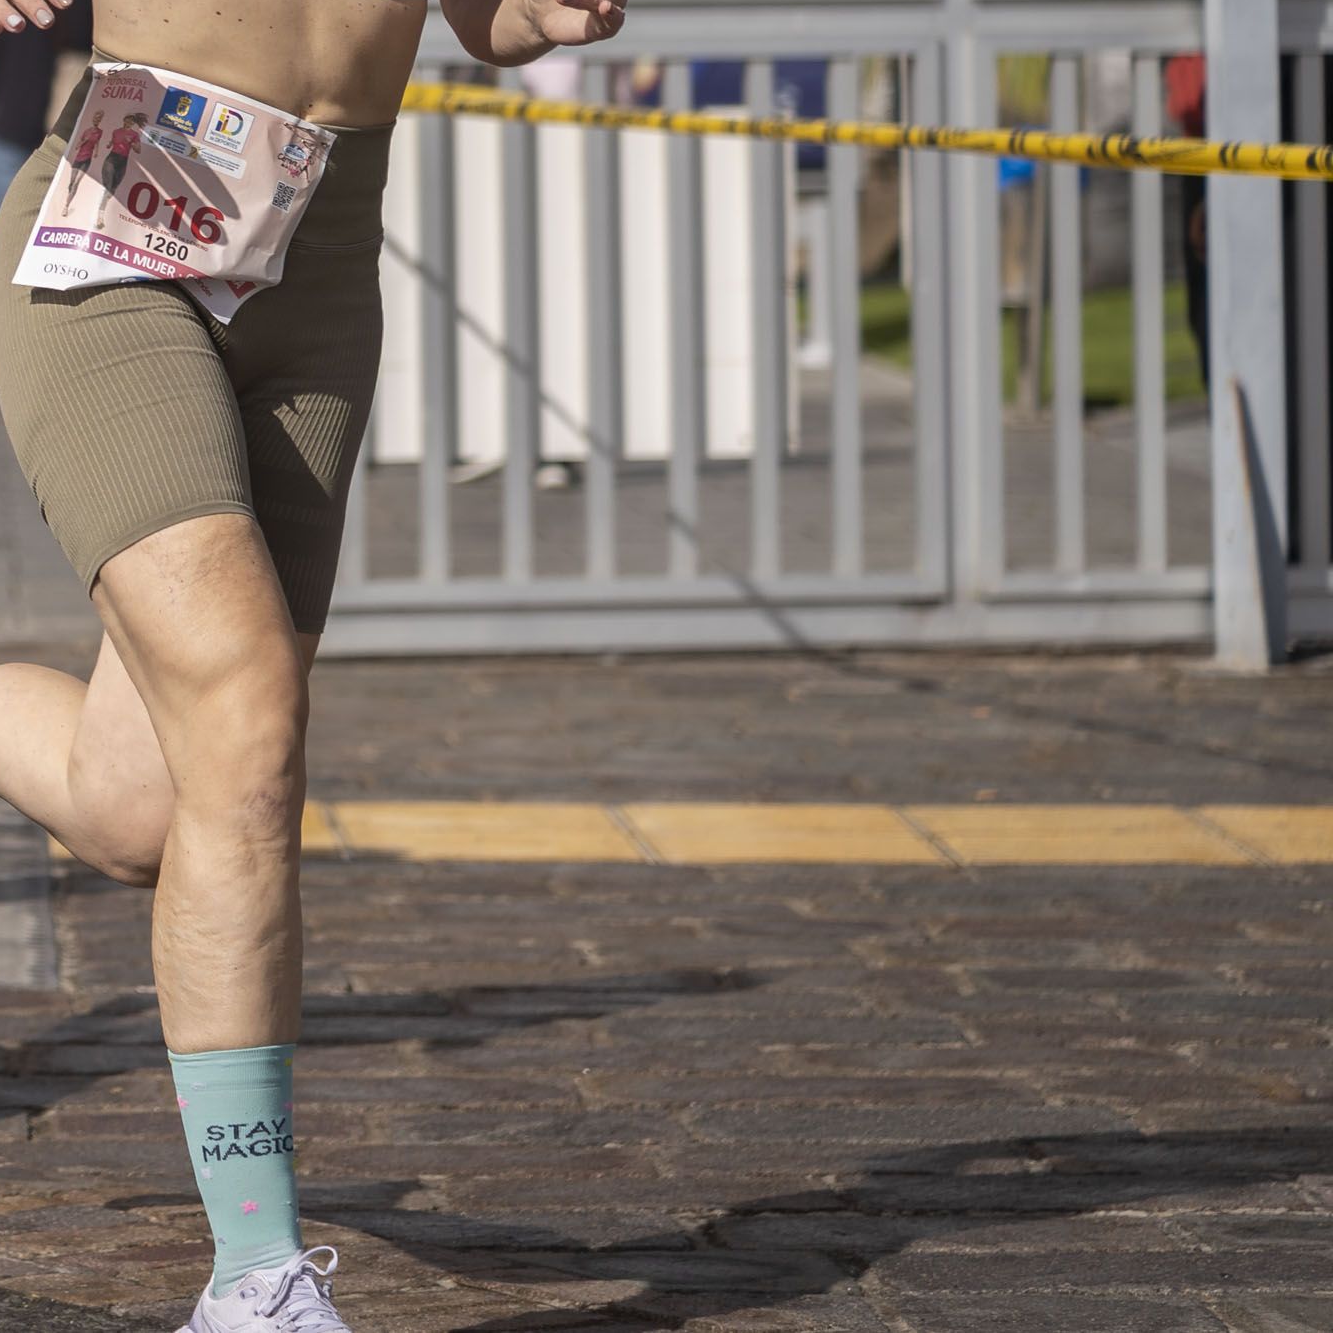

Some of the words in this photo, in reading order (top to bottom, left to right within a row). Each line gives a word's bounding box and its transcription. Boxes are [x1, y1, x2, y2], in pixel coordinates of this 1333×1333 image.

[101, 85, 144, 103] SUMA
[127, 180, 225, 245] 016
[40, 231, 90, 249] CARRERA
[94, 239, 110, 255] DE
[113, 246, 130, 262] LA
[132, 253, 177, 279] MUJER
[144, 232, 189, 261] 1260
[43, 263, 89, 281] OYSHO
[206, 1117, 286, 1141] STAY
[202, 1135, 294, 1162] MAGIC
